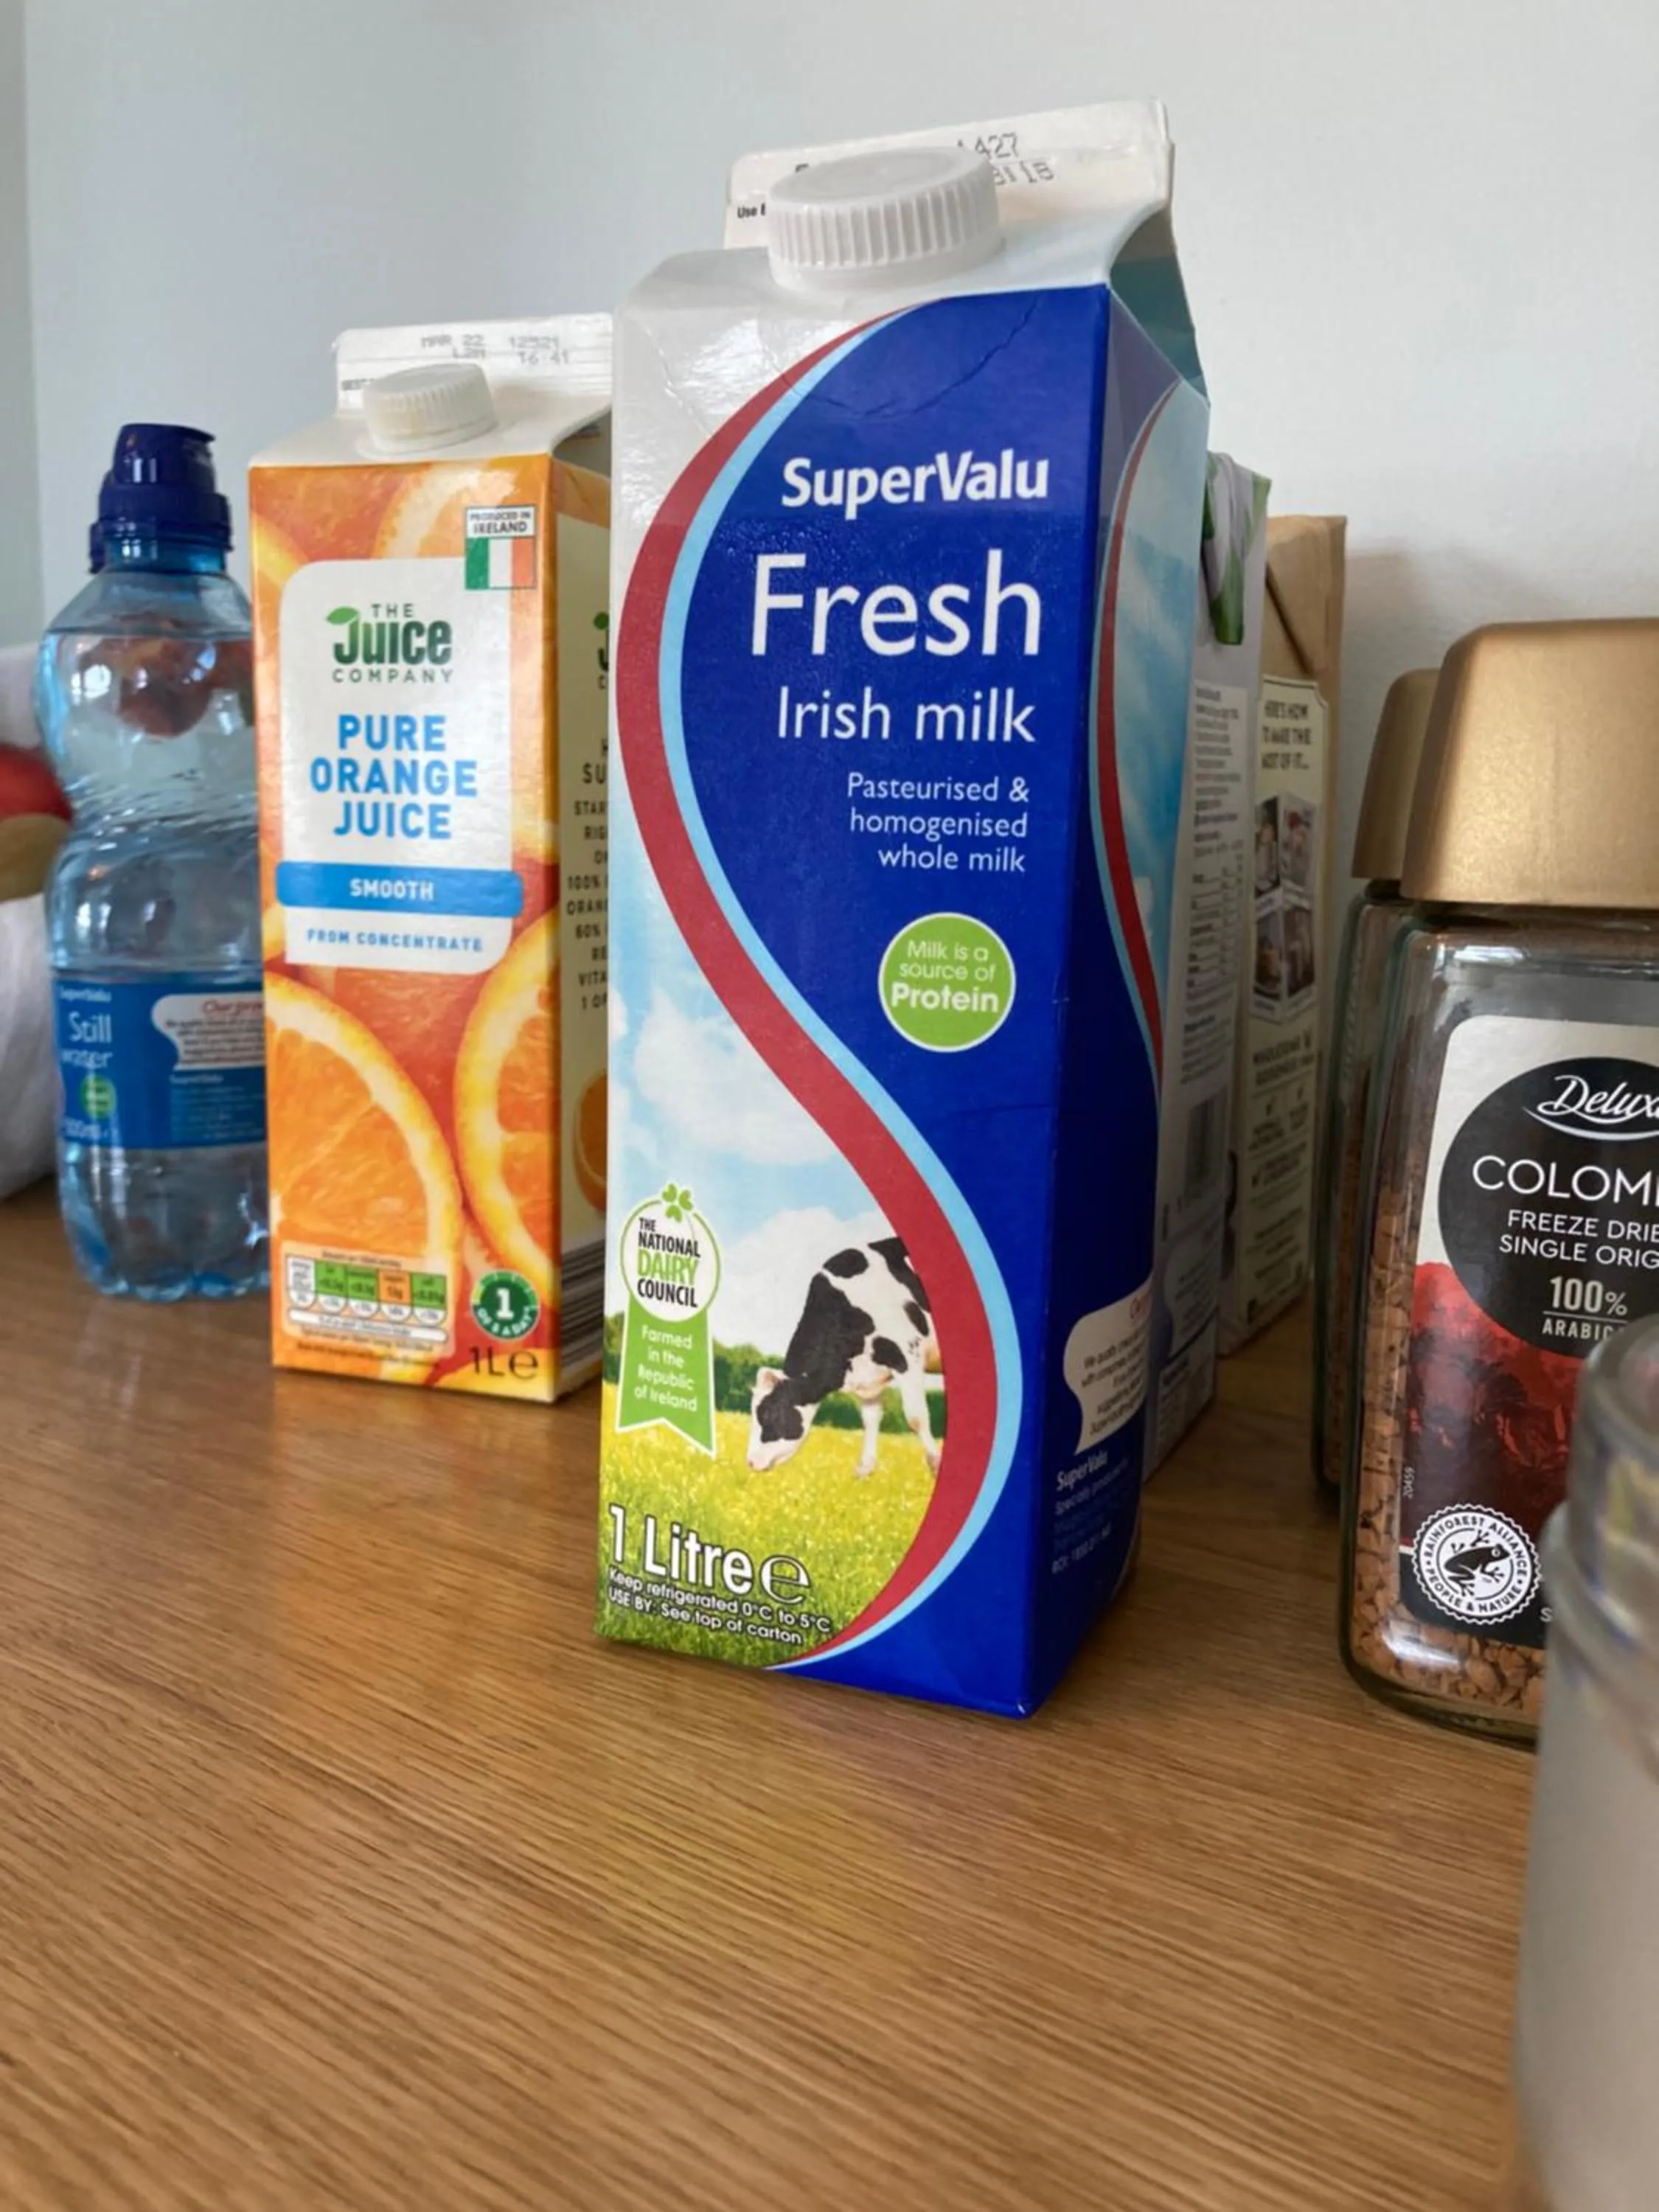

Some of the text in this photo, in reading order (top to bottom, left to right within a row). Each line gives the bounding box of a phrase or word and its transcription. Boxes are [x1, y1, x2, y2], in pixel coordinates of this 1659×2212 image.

[737, 206, 758, 219] Use
[782, 448, 1049, 521] SuperValu
[473, 521, 528, 534] IRELAND
[371, 603, 414, 618] THE
[752, 549, 1041, 656] Fresh
[332, 669, 453, 684] COMPANY
[779, 686, 1036, 742] Irish milk
[338, 714, 447, 751] PURE
[310, 757, 478, 797] ORANGE
[848, 772, 1030, 802] Pasteurised &
[333, 801, 452, 839] JUICE
[849, 807, 1028, 842] homogenised
[878, 844, 1026, 872] whole milk
[349, 877, 435, 900] SMOOTH
[307, 928, 483, 952] FROM CONCENTRATE
[908, 939, 989, 962] Milk is a
[899, 962, 996, 983] source of
[891, 981, 999, 1013] Protein
[1472, 1155, 1659, 1208] COLOM
[639, 1217, 655, 1232] THE
[1507, 1210, 1599, 1237] FREEZE
[638, 1231, 701, 1259] NATIONAL
[1499, 1234, 1587, 1262] SINGLE
[638, 1248, 699, 1287] DAIRY
[496, 1287, 514, 1321] 1
[637, 1278, 698, 1308] COUNCIL
[1550, 1276, 1628, 1316] 100%
[642, 1324, 692, 1350] Farmed
[649, 1346, 684, 1369] in the
[638, 1363, 695, 1391] Republic
[635, 1384, 698, 1412] of Ireland
[609, 1503, 625, 1562] 1
[644, 1514, 754, 1595] Litre
[1425, 1516, 1528, 1576] RAINFOREST ALLIANCE
[608, 1567, 831, 1633] Keep refrigerated 0°C to 5°C
[1426, 1568, 1522, 1613] PEOPLE & NATURE
[608, 1586, 630, 1607] USE
[661, 1603, 690, 1622] See
[695, 1610, 722, 1630] top
[726, 1618, 742, 1632] of
[747, 1624, 803, 1645] carton
